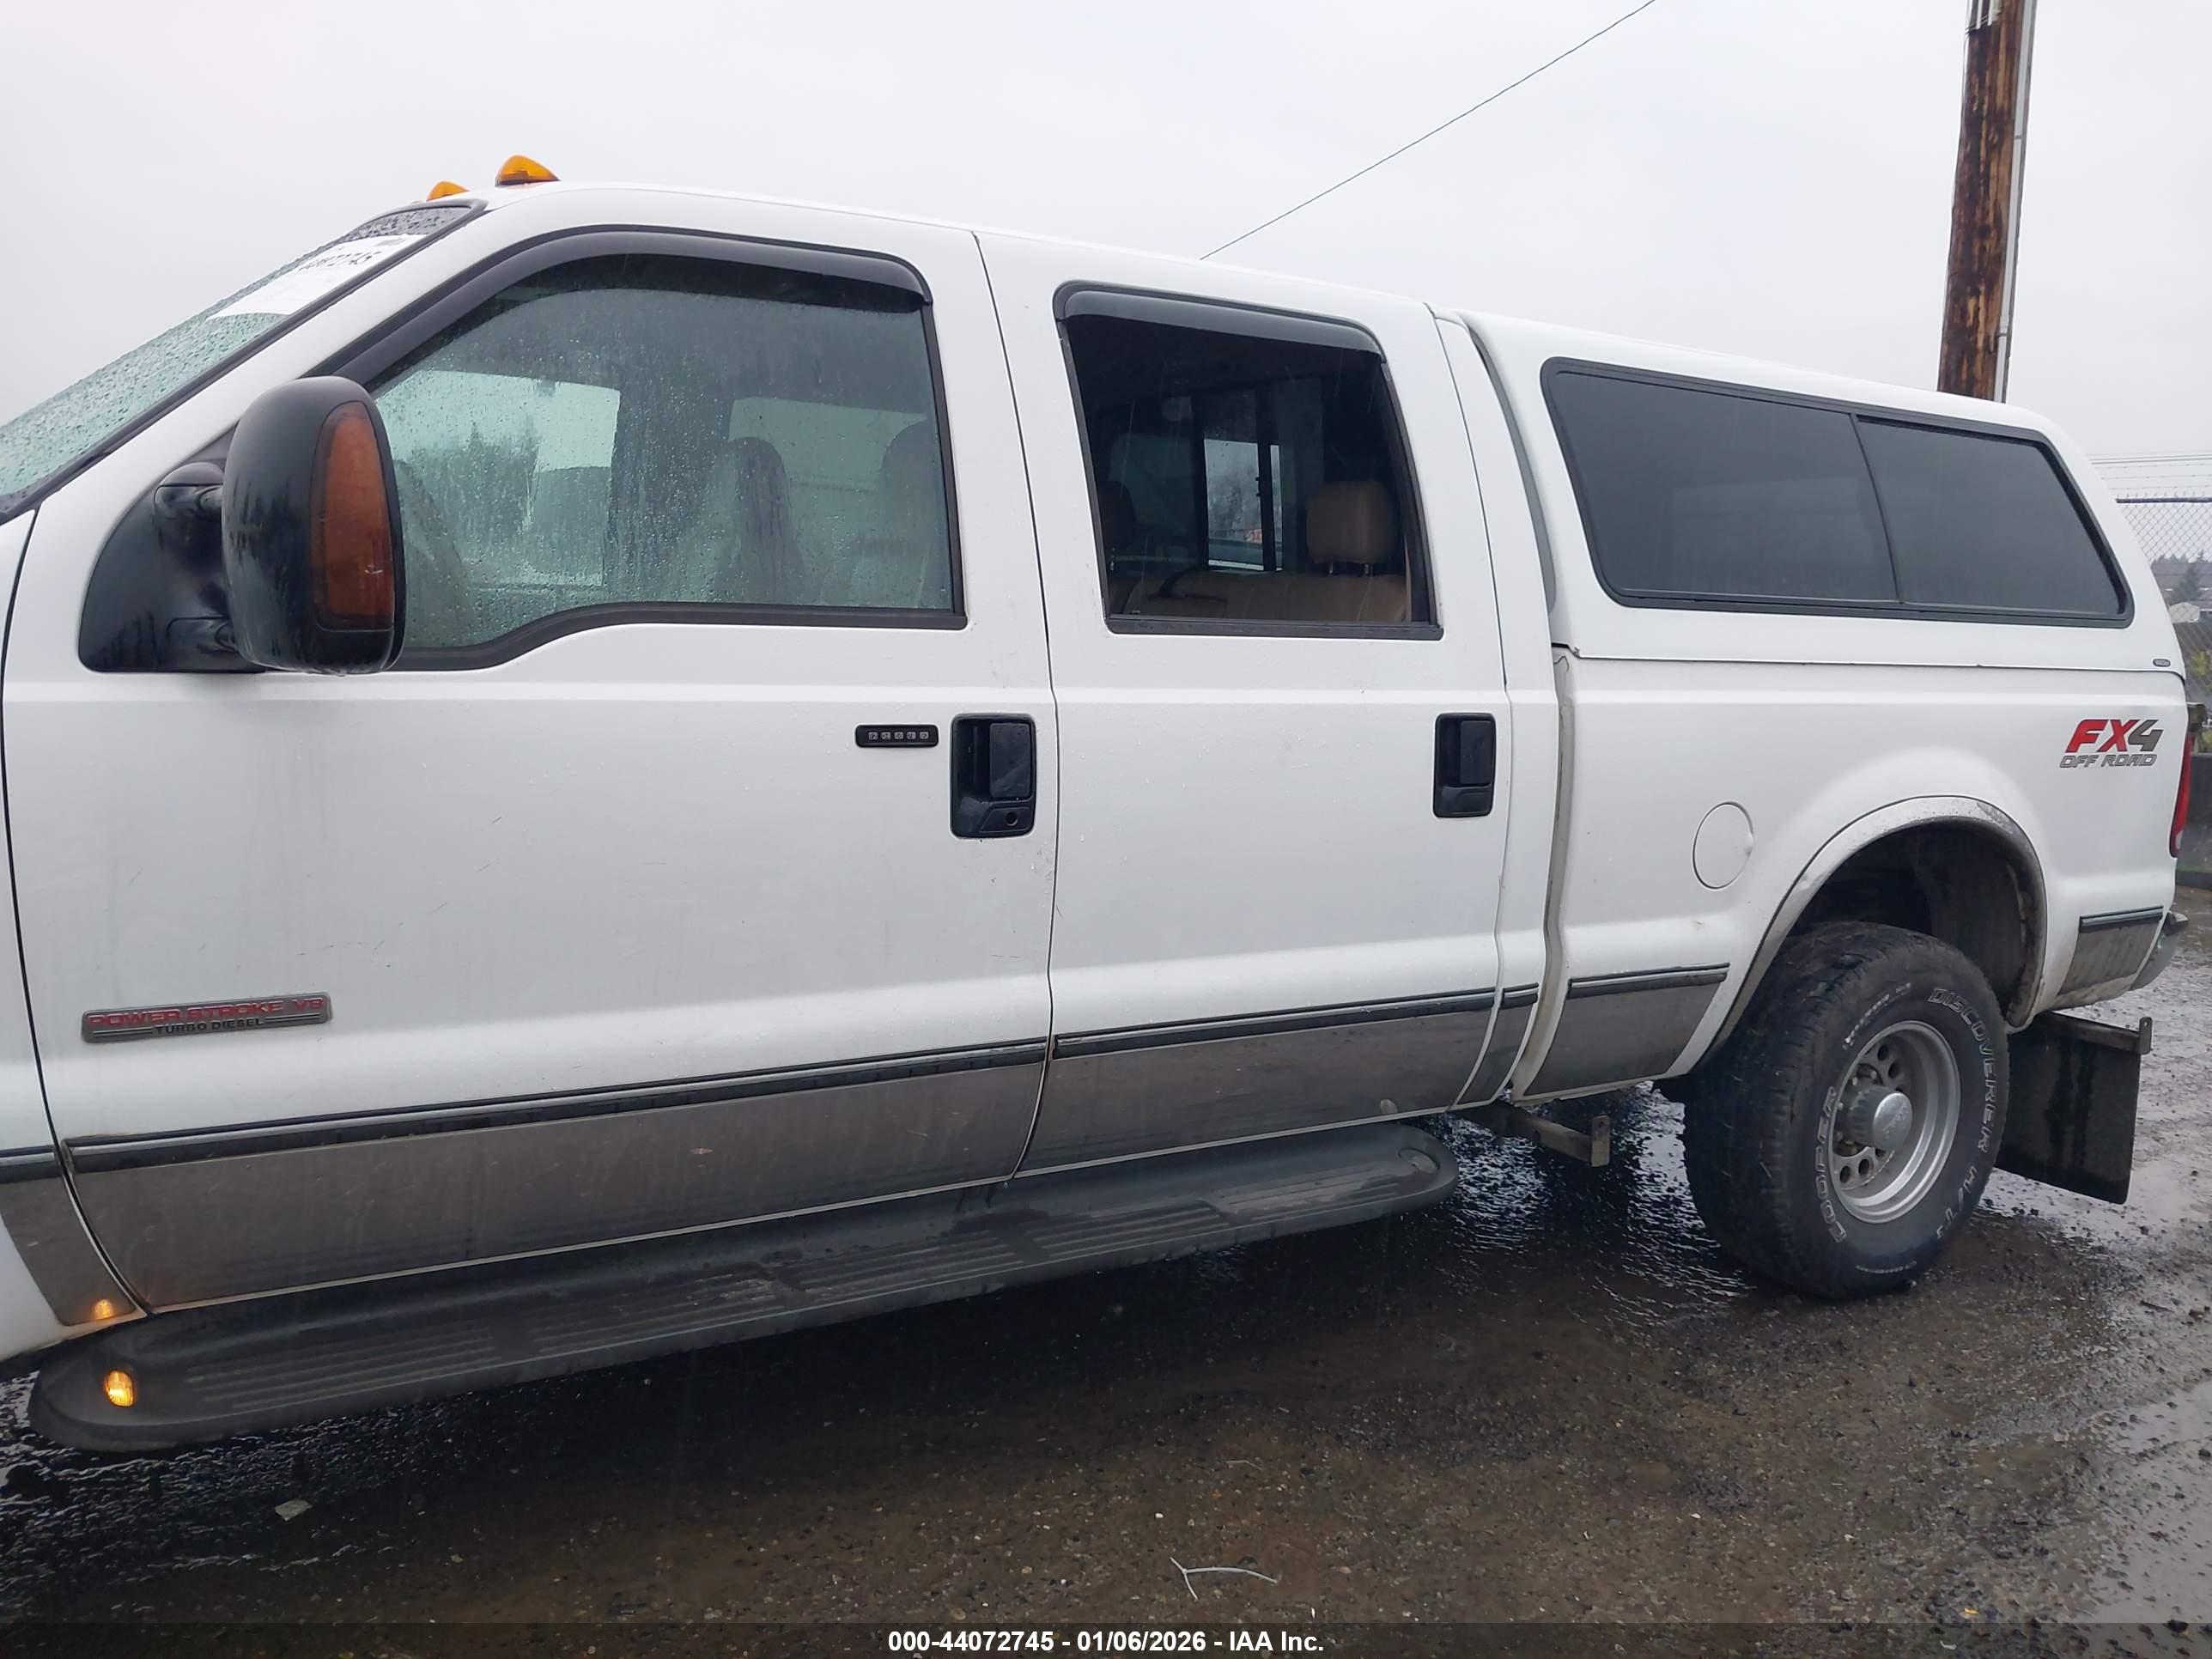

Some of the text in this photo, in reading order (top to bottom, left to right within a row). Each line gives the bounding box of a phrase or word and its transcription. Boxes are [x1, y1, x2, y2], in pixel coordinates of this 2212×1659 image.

[2064, 719, 2164, 753] FX4
[2059, 753, 2157, 769] OFF ROAD
[88, 996, 325, 1027] POWER STROKE V8
[155, 1017, 264, 1035] TURBO DIESEL
[1927, 987, 1996, 1153] DISCOVERER
